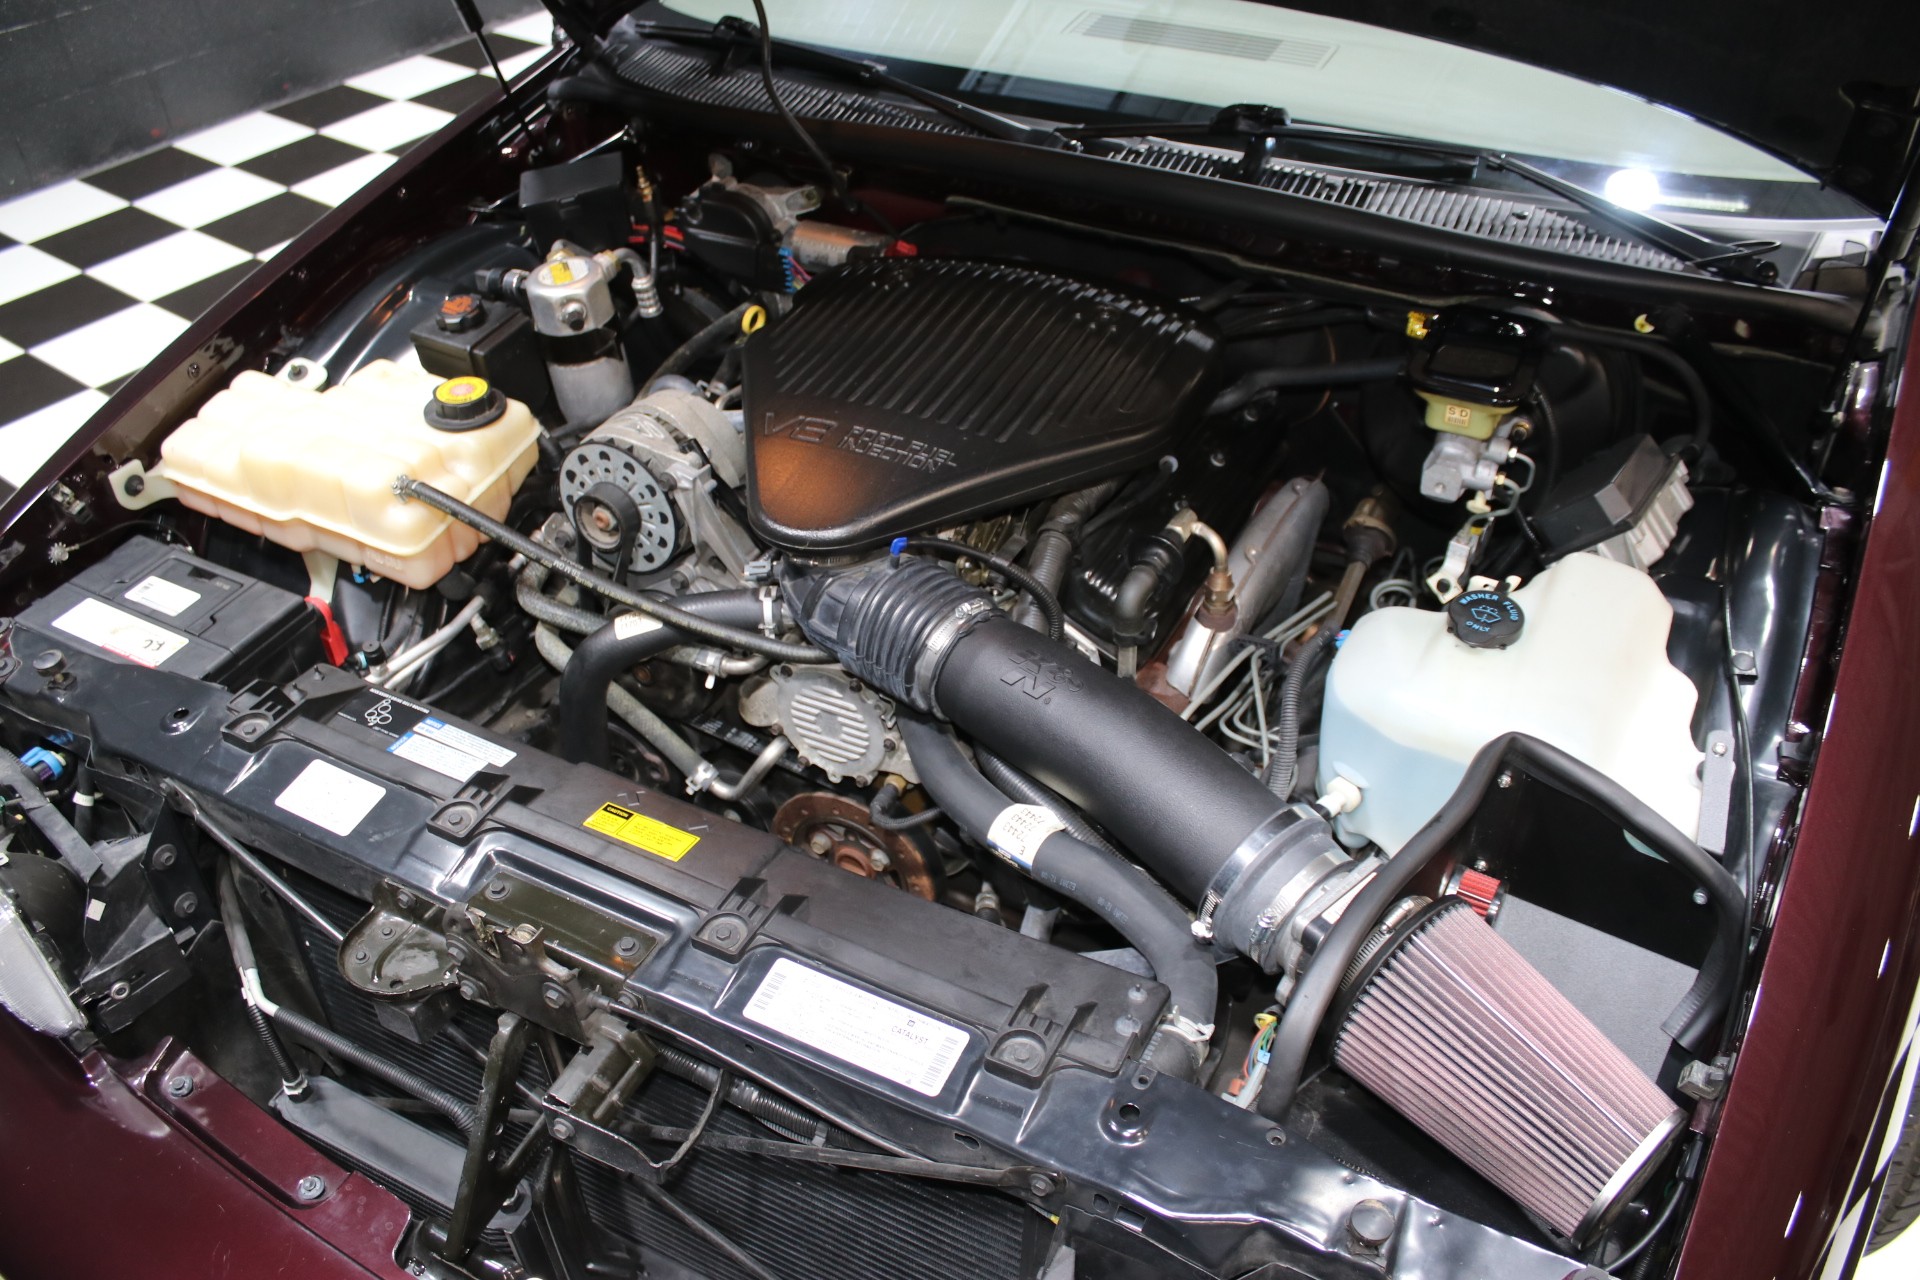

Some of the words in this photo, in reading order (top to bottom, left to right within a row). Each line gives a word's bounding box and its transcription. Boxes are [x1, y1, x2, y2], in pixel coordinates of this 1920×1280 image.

[837, 436, 942, 474] INJECTION
[847, 425, 904, 445] PORT
[908, 440, 958, 467] FUEL
[1458, 593, 1499, 605] WASHER
[1502, 601, 1519, 621] FLUID
[1465, 620, 1491, 632] ONLY
[606, 806, 628, 817] CAUTION
[890, 1025, 930, 1045] CATALYST
